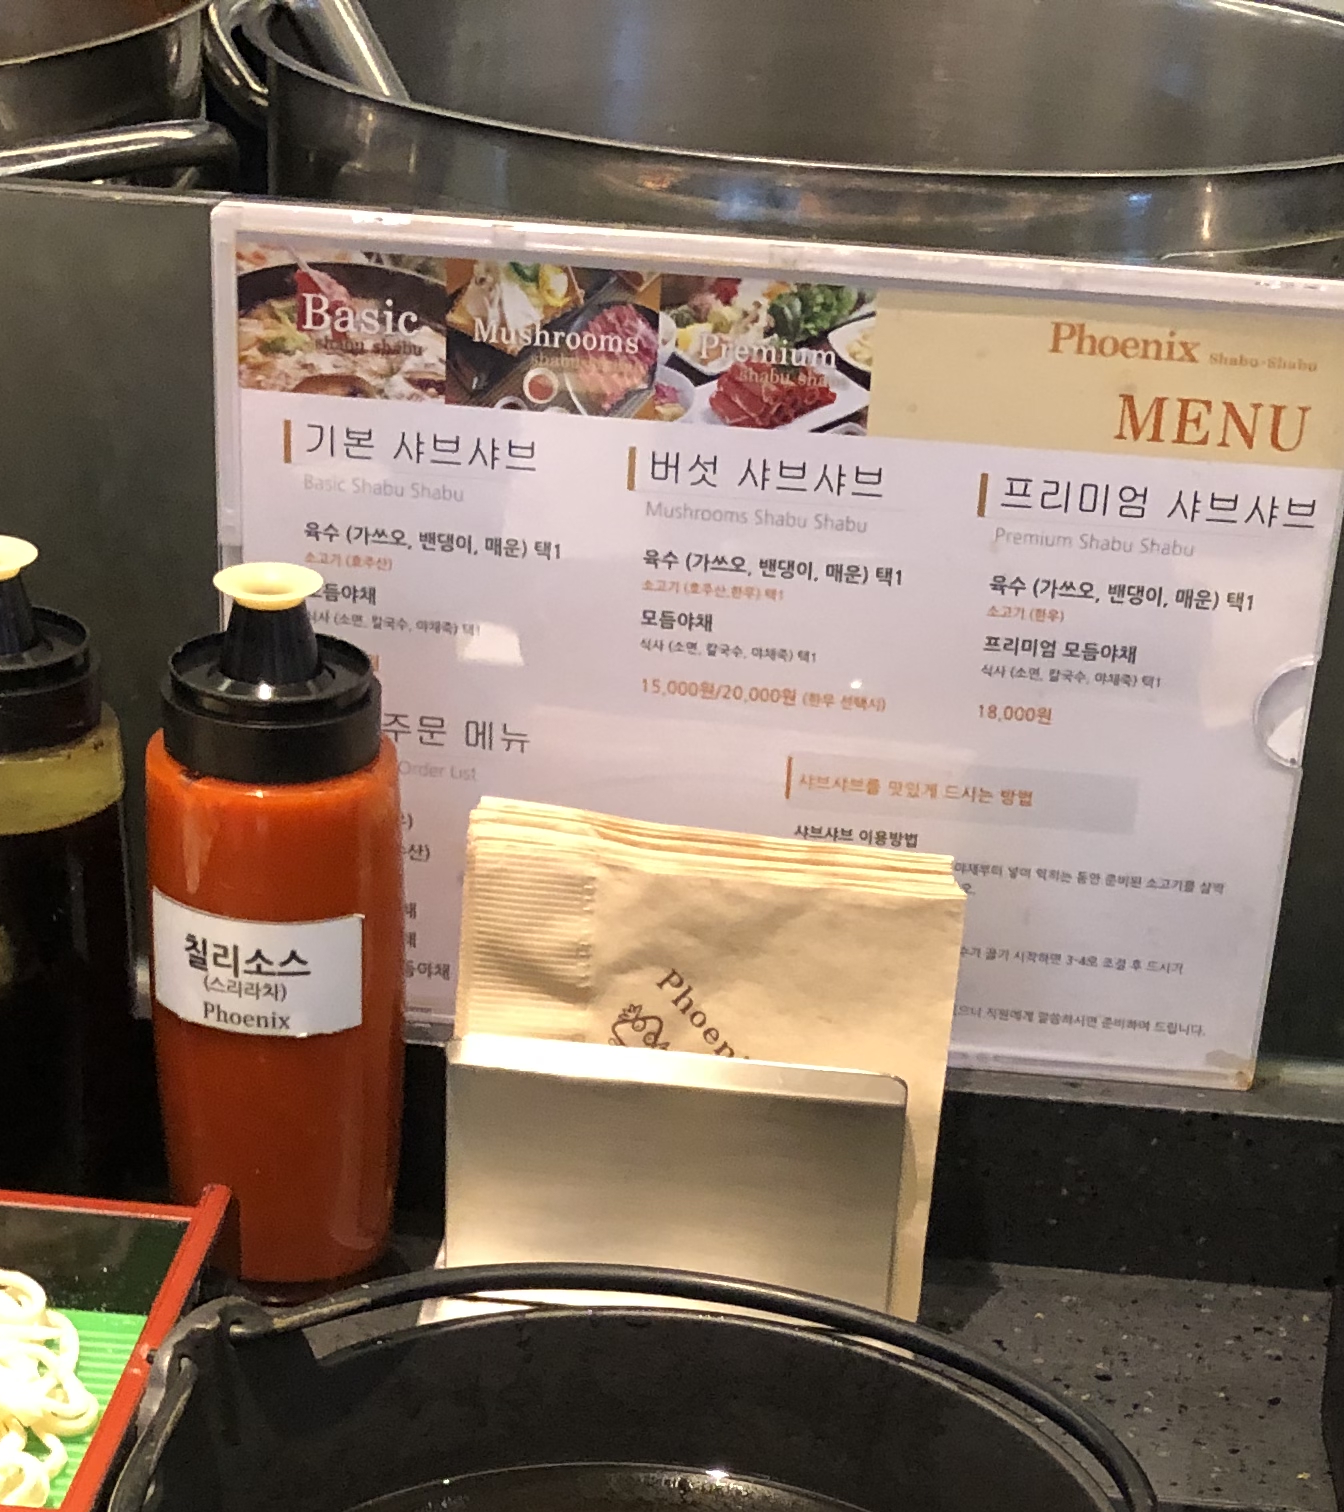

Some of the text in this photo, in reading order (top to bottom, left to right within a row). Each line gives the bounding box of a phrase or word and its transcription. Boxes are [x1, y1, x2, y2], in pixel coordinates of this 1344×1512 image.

[302, 292, 418, 336] Basic
[472, 318, 639, 355] Mushrooms
[699, 332, 837, 369] Premium
[1048, 321, 1201, 363] Phoenix
[1113, 393, 1312, 452] MENU
[307, 424, 537, 471] 기본 샤브샤브
[304, 474, 464, 502] Basic Shabu Shabu
[651, 451, 883, 497] 버섯 샤브샤브
[645, 501, 868, 534] Mushrooms Shabu Shabu
[1001, 477, 1316, 528] 프리미엄 샤브샤브
[304, 522, 561, 560] 육수 (가쓰오, 밴댕이, 매운) 택1
[995, 527, 1194, 558] Premium Shabu Shabu
[304, 552, 343, 567] 소고기
[643, 549, 903, 587] 육수 (가쓰오, 밴댕이, 매운) 택1
[642, 579, 680, 595] 소고기
[989, 575, 1254, 612] 육수 (가쓰오, 밴댕이, 매운) 택1
[641, 609, 713, 633] 모듬야채
[986, 604, 1025, 621] 소고기
[983, 635, 1137, 664] 프리미엄 모듬야채
[382, 713, 530, 754] 주문 메뉴
[399, 760, 477, 782] Order List
[944, 785, 993, 804] 드시는
[794, 824, 919, 849] 샤브샤브 이용방법
[185, 932, 311, 978] 칠리소스
[404, 960, 451, 981] 듬야채
[203, 973, 288, 1002] (스리라차)
[203, 1001, 291, 1030] Phoenix
[656, 967, 750, 1060] Phoen
